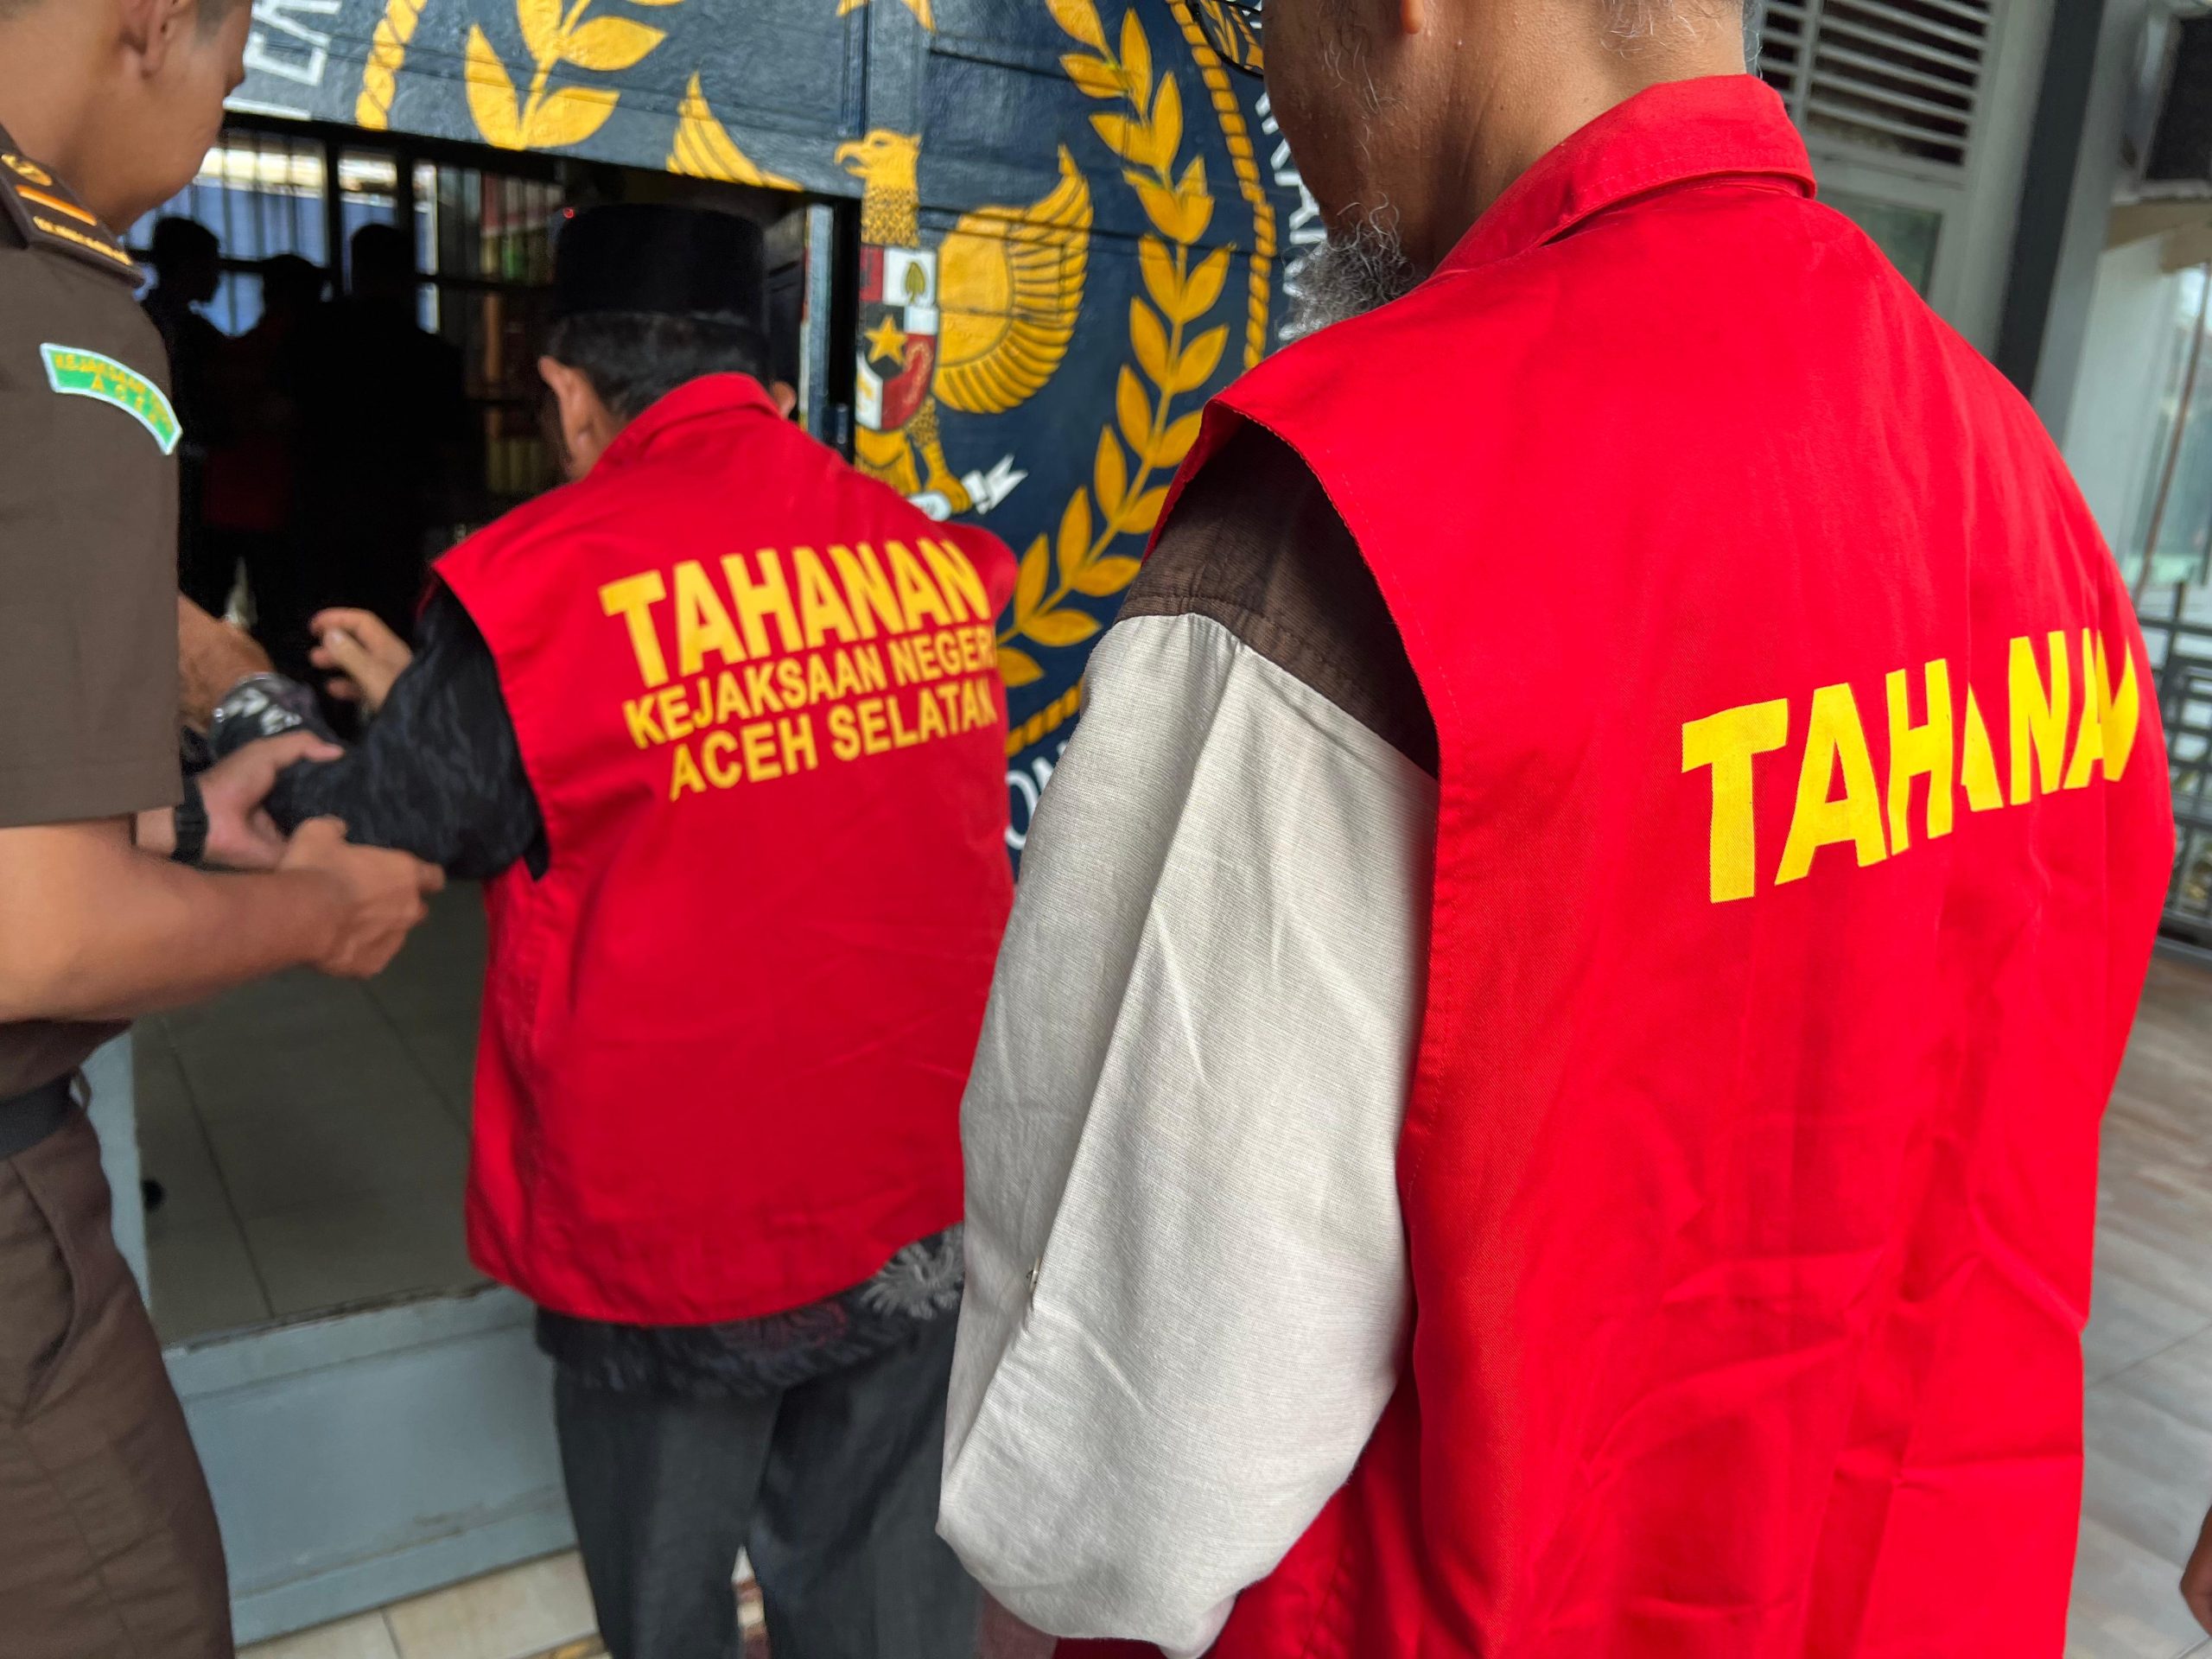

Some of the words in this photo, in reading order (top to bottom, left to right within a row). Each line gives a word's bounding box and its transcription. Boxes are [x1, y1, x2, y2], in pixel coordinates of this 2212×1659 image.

[599, 538, 991, 687] TAHANAN
[623, 646, 887, 748] KEJAKSAAN
[889, 626, 998, 689] NEGER
[669, 711, 818, 804] ACEH
